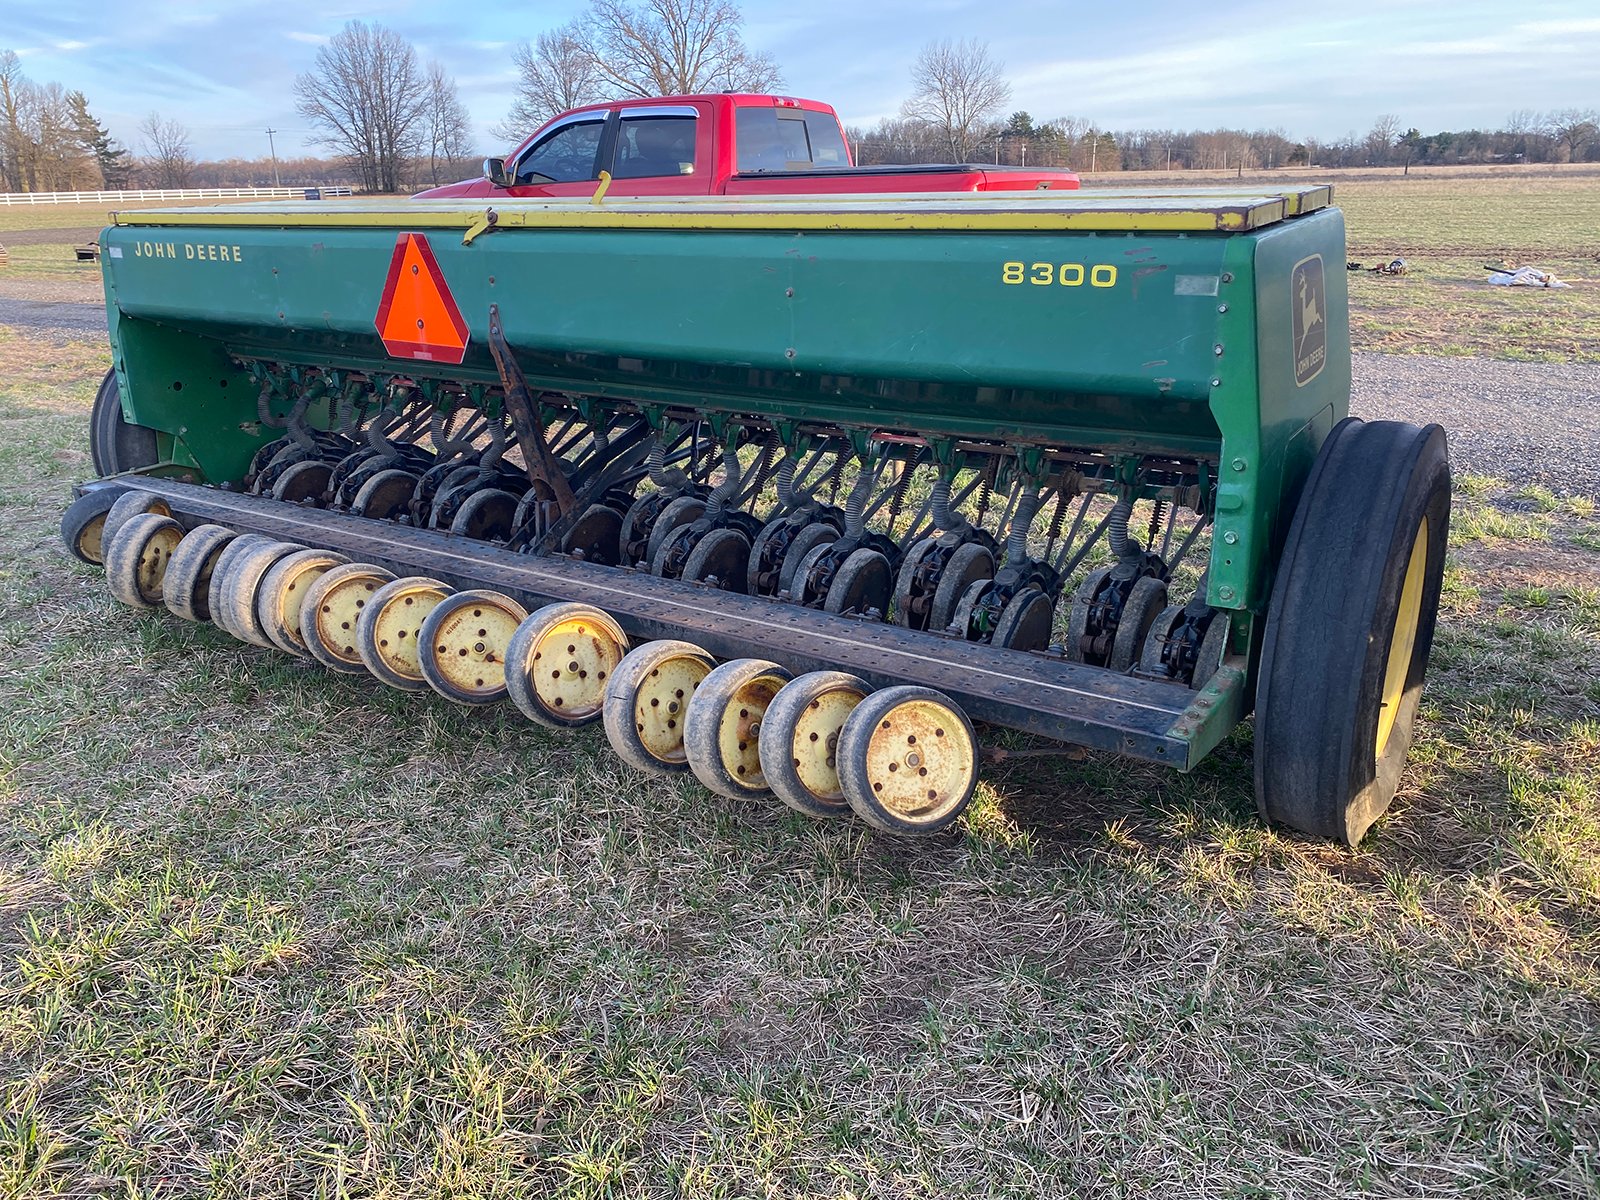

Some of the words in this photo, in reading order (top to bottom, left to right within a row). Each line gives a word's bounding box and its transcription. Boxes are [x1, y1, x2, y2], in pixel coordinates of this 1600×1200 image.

[135, 241, 176, 259] JOHN
[184, 244, 242, 262] DEERE
[1002, 261, 1118, 288] 8300
